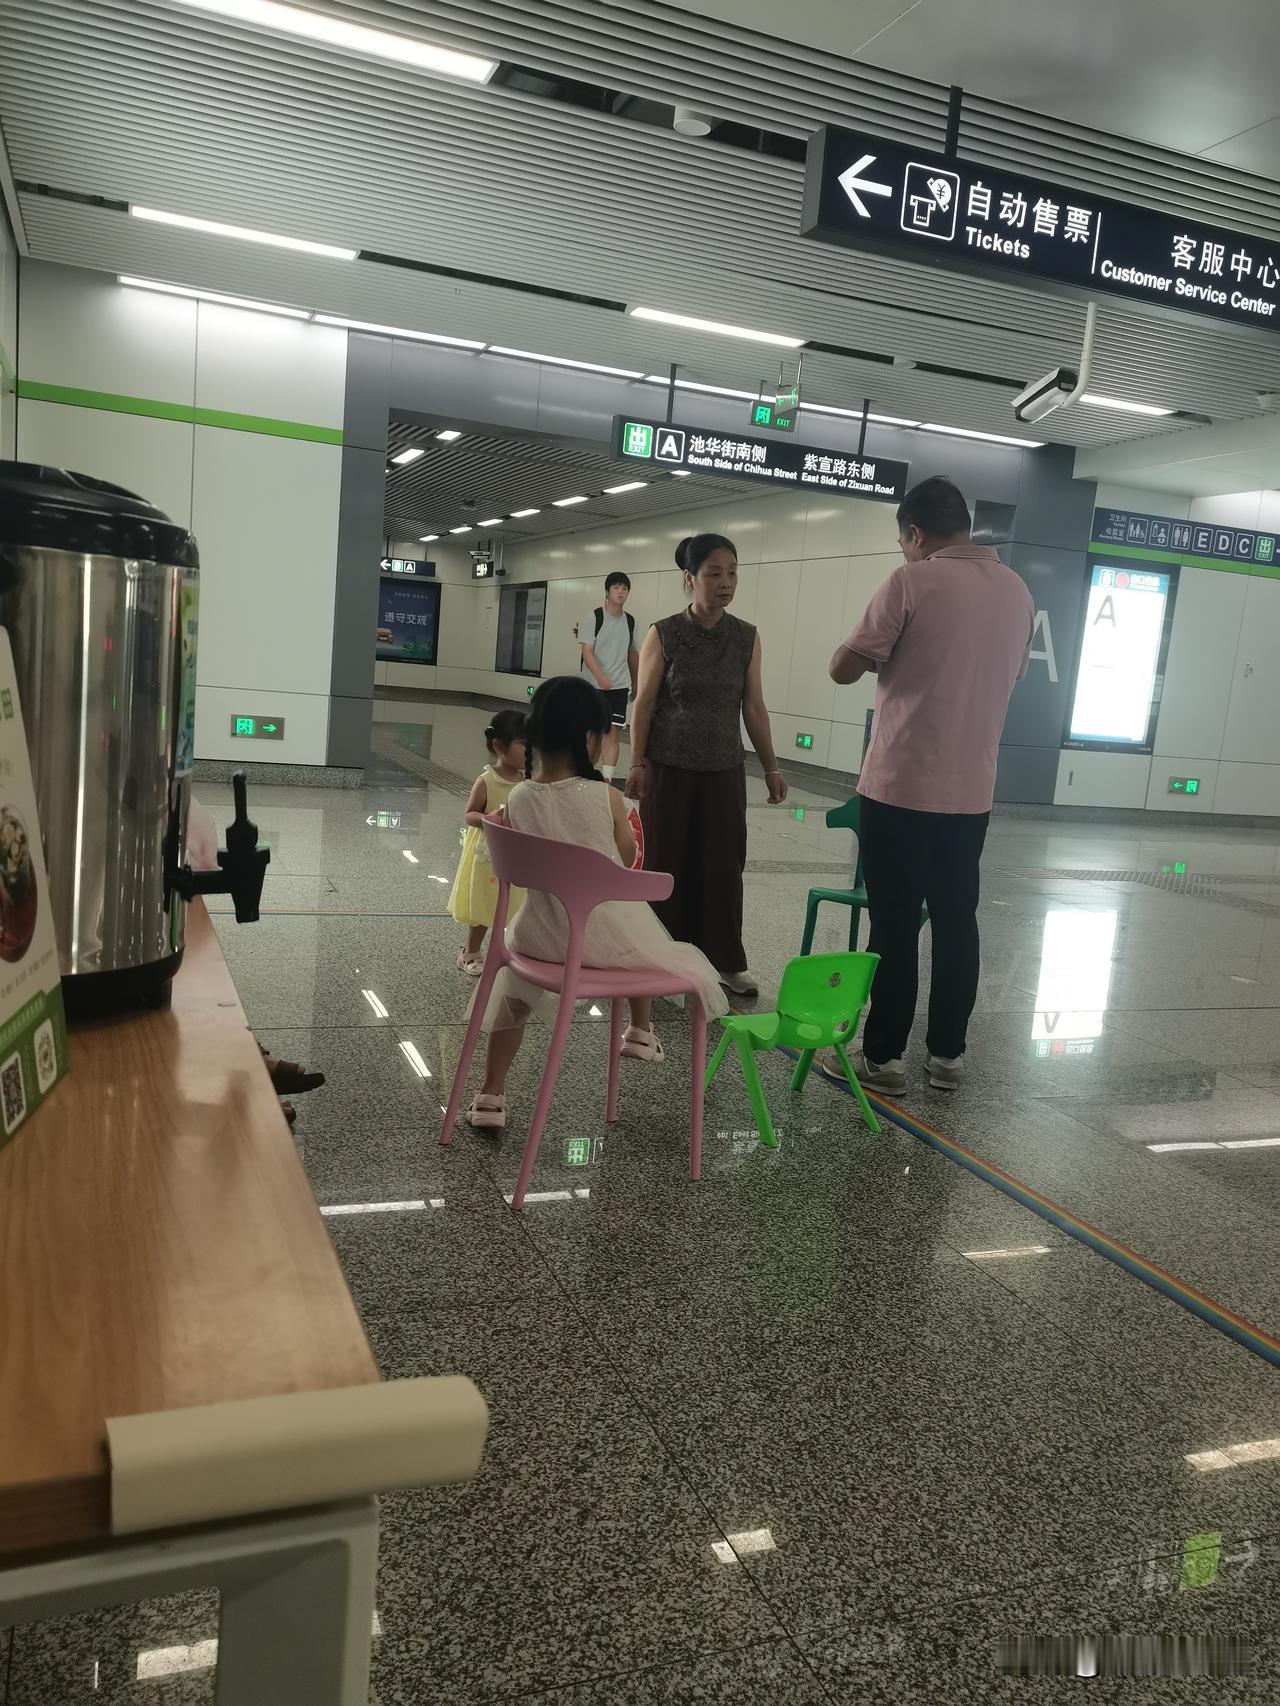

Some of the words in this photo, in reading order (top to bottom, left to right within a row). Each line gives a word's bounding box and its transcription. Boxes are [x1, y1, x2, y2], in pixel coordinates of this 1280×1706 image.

[967, 181, 1093, 243] 自动售票
[965, 227, 1030, 259] Tickets
[1171, 235, 1280, 288] 客服中心
[1101, 260, 1172, 292] Customer
[1175, 277, 1227, 305] Service
[1231, 291, 1276, 316] Center
[776, 418, 790, 427] EXIT
[660, 435, 679, 457] A
[689, 435, 766, 463] 池华街南侧
[688, 454, 712, 468] South
[714, 459, 732, 470] Side
[734, 462, 743, 471] of
[744, 463, 772, 477] Chihua
[774, 468, 797, 480] Street
[803, 453, 875, 481] 紫宣路东侧
[801, 472, 819, 484] East
[820, 475, 837, 486] Side
[838, 477, 847, 487] of
[848, 478, 873, 492] Zixuan
[874, 483, 895, 495] Road
[1197, 531, 1208, 548] E
[1218, 534, 1230, 551] D
[1239, 538, 1250, 554] C
[405, 563, 414, 571] A
[1092, 594, 1117, 628] A
[1028, 609, 1059, 683] A
